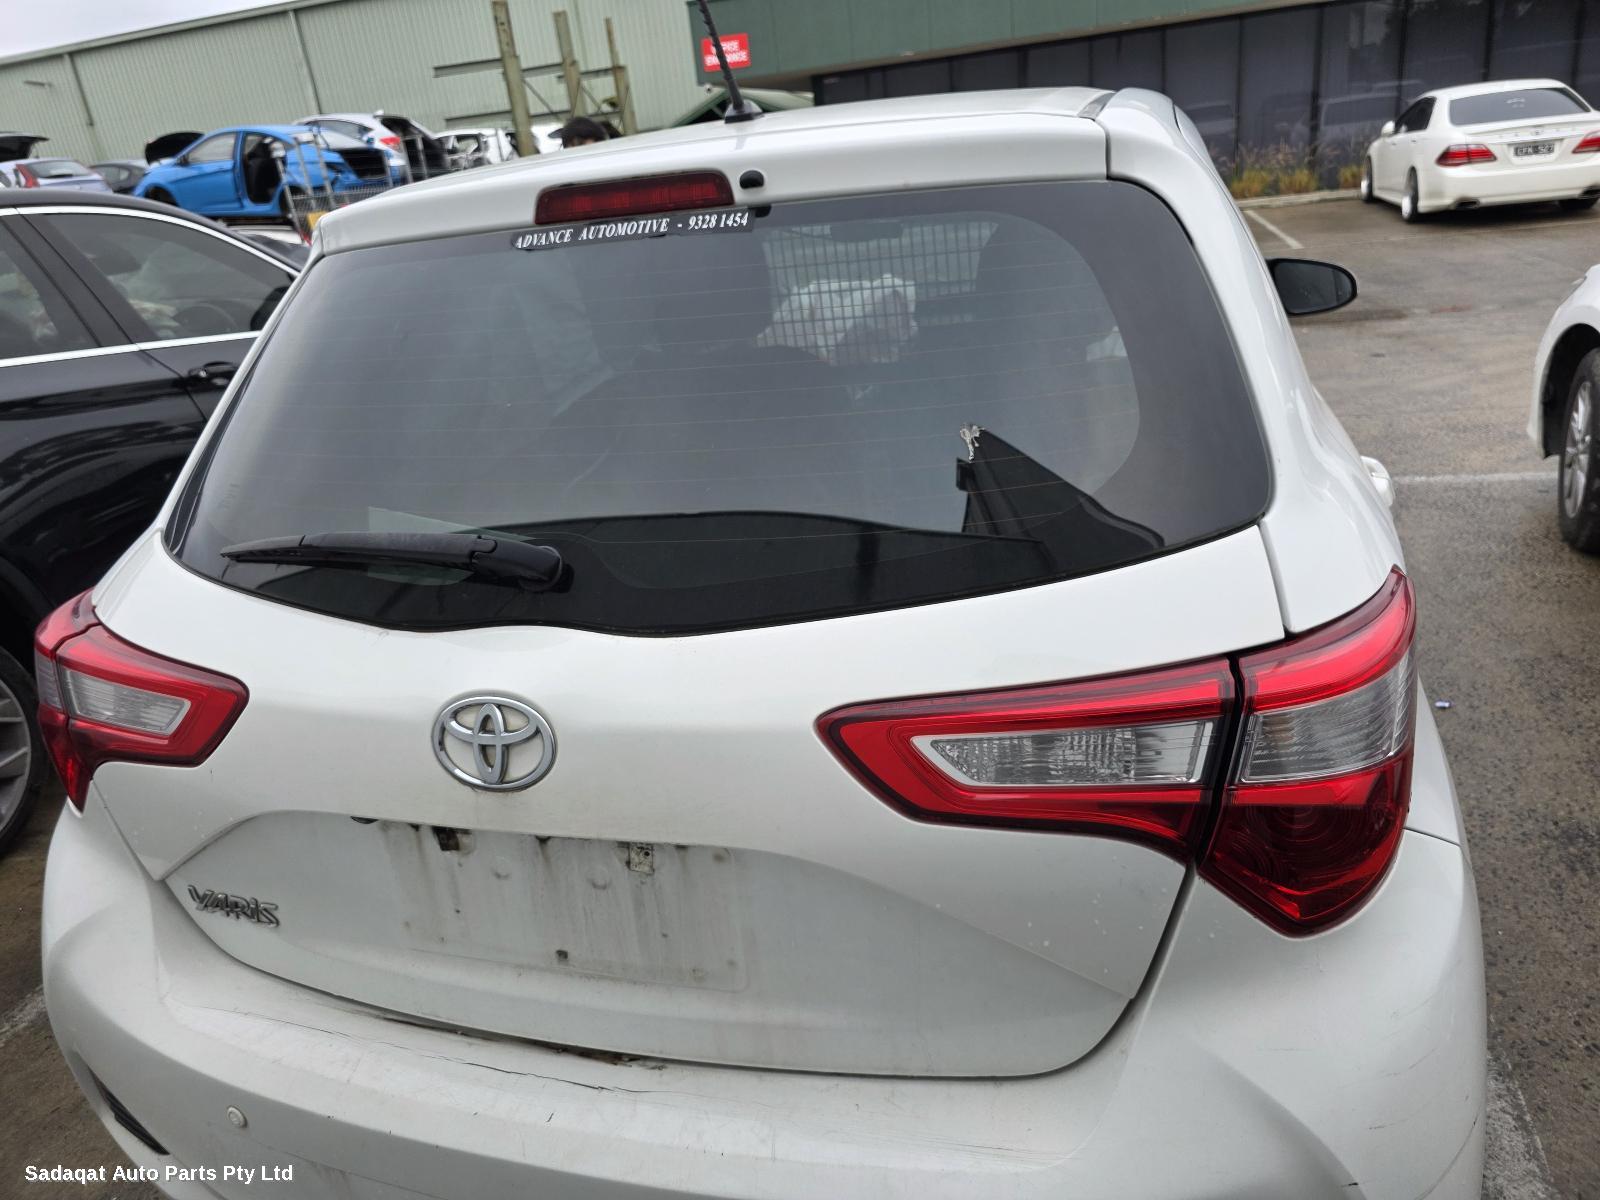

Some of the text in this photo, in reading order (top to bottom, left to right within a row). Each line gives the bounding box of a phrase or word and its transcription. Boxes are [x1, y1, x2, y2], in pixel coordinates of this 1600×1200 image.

[515, 228, 573, 249] ADVANCE
[578, 217, 670, 241] AUTOMOTIVE
[687, 212, 718, 231] 9328
[719, 211, 749, 230] 1454
